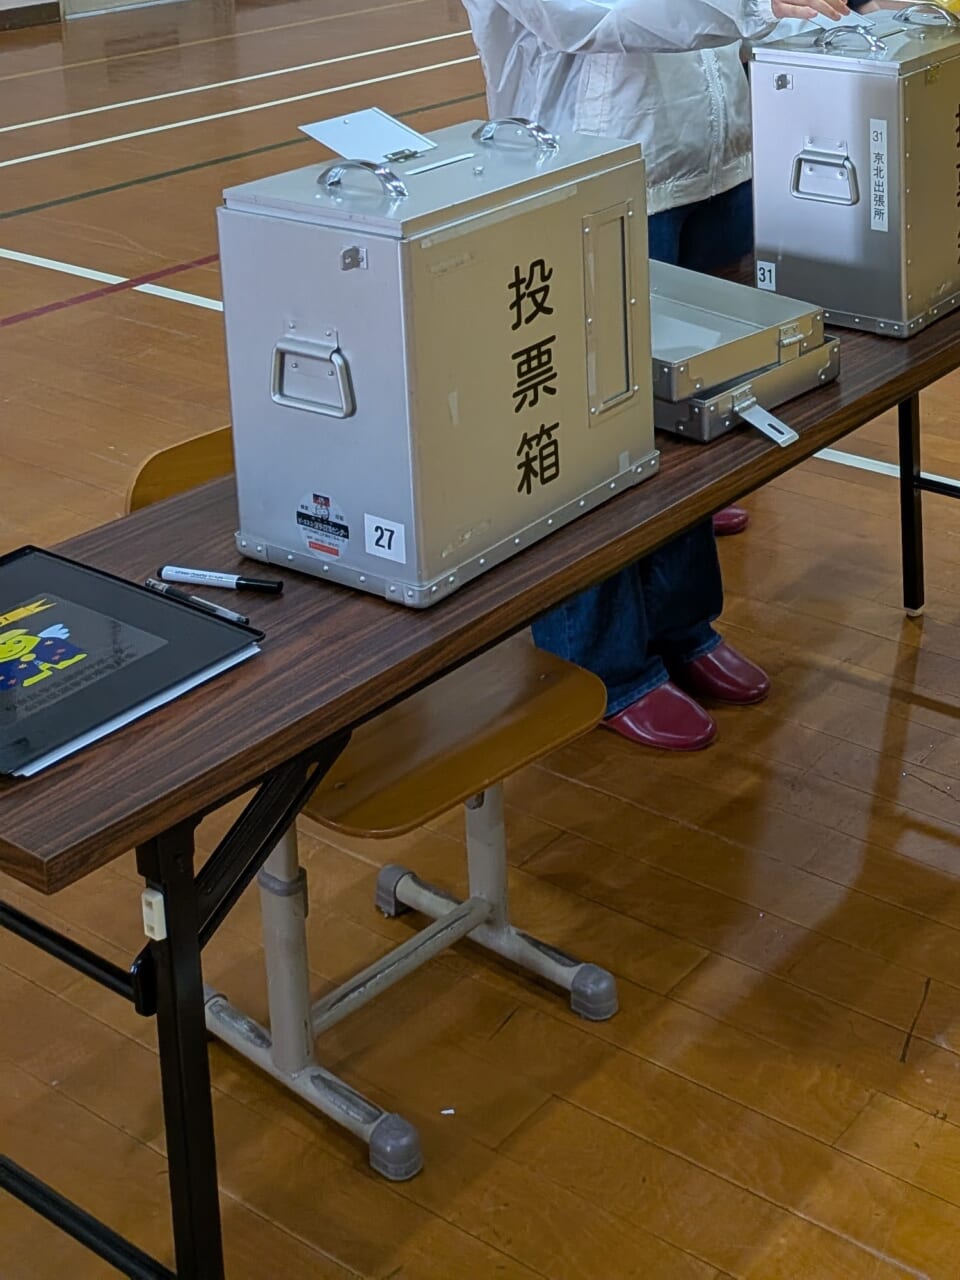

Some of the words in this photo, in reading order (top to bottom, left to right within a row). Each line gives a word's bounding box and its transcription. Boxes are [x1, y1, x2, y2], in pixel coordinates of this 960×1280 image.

[872, 130, 883, 143] 31
[872, 151, 885, 222] 京北出張所
[758, 266, 773, 284] 31
[506, 258, 561, 496] 投票箱
[374, 525, 395, 551] 27
